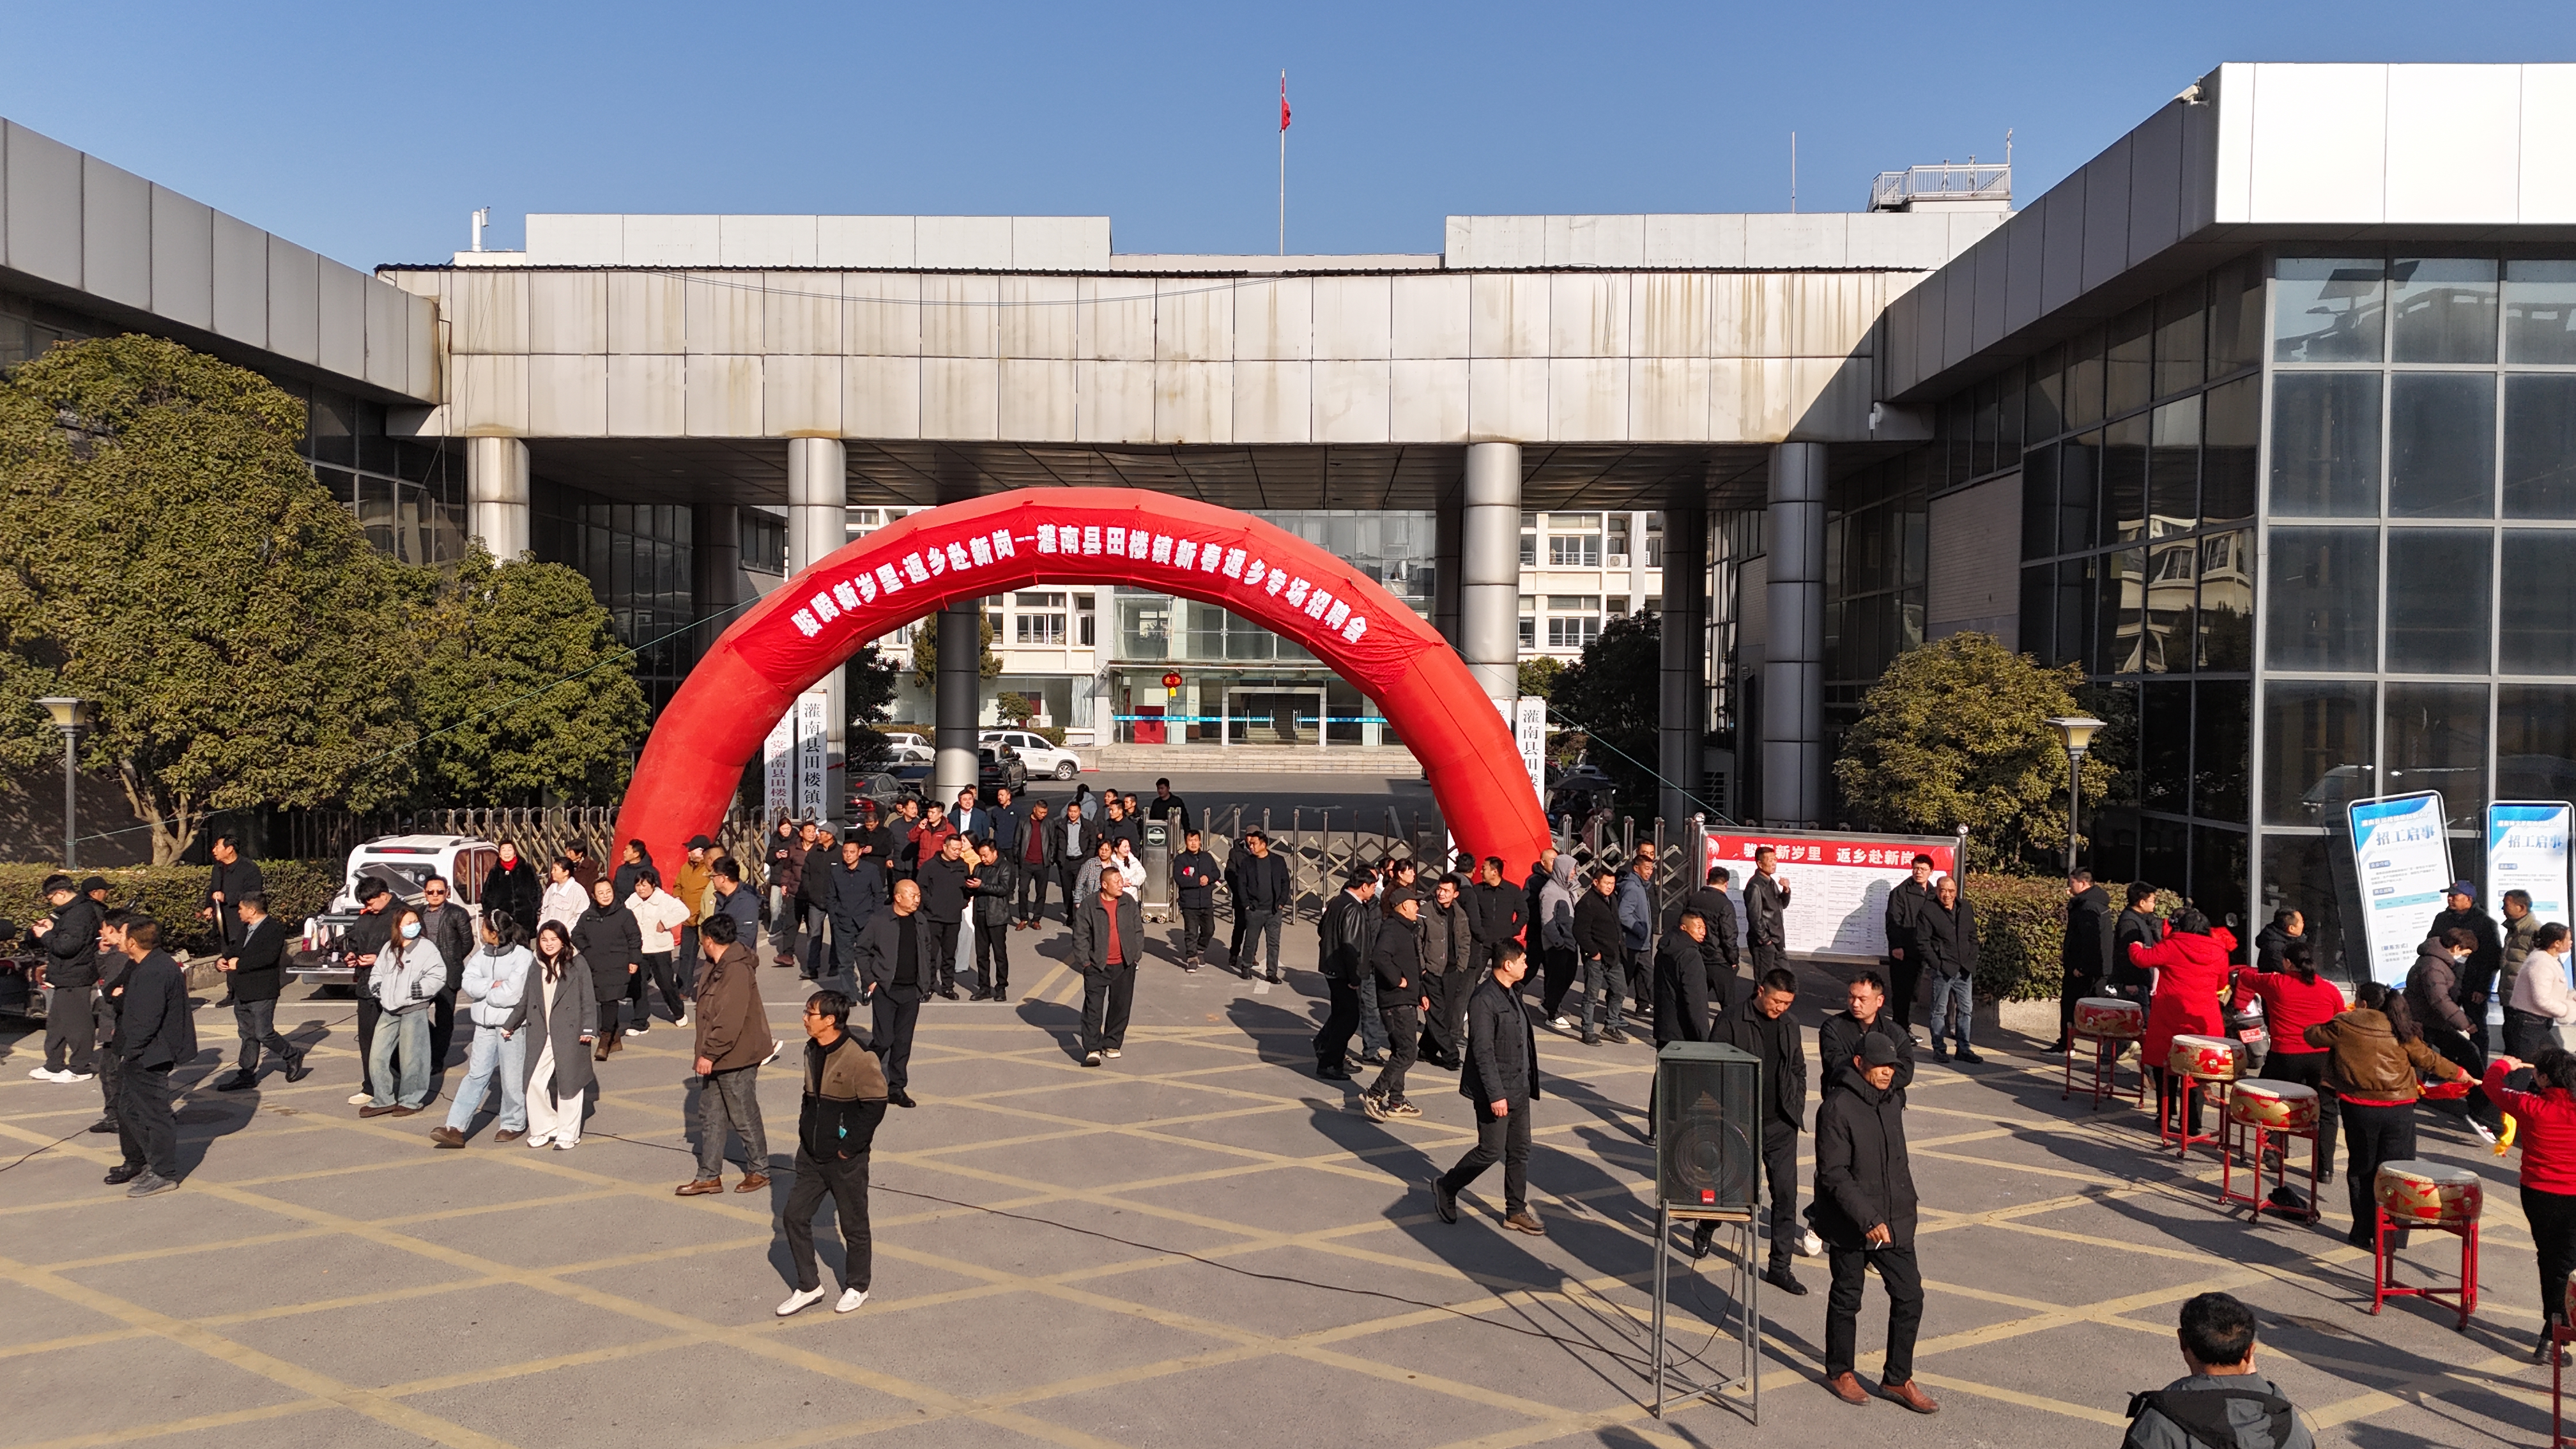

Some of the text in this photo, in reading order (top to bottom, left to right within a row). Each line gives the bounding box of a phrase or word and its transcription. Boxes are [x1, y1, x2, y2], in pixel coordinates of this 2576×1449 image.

[2376, 824, 2435, 846] 招工启事
[2508, 834, 2563, 848] 招工启事
[1744, 843, 1915, 866] 骏新岁里 返乡赴新岗
